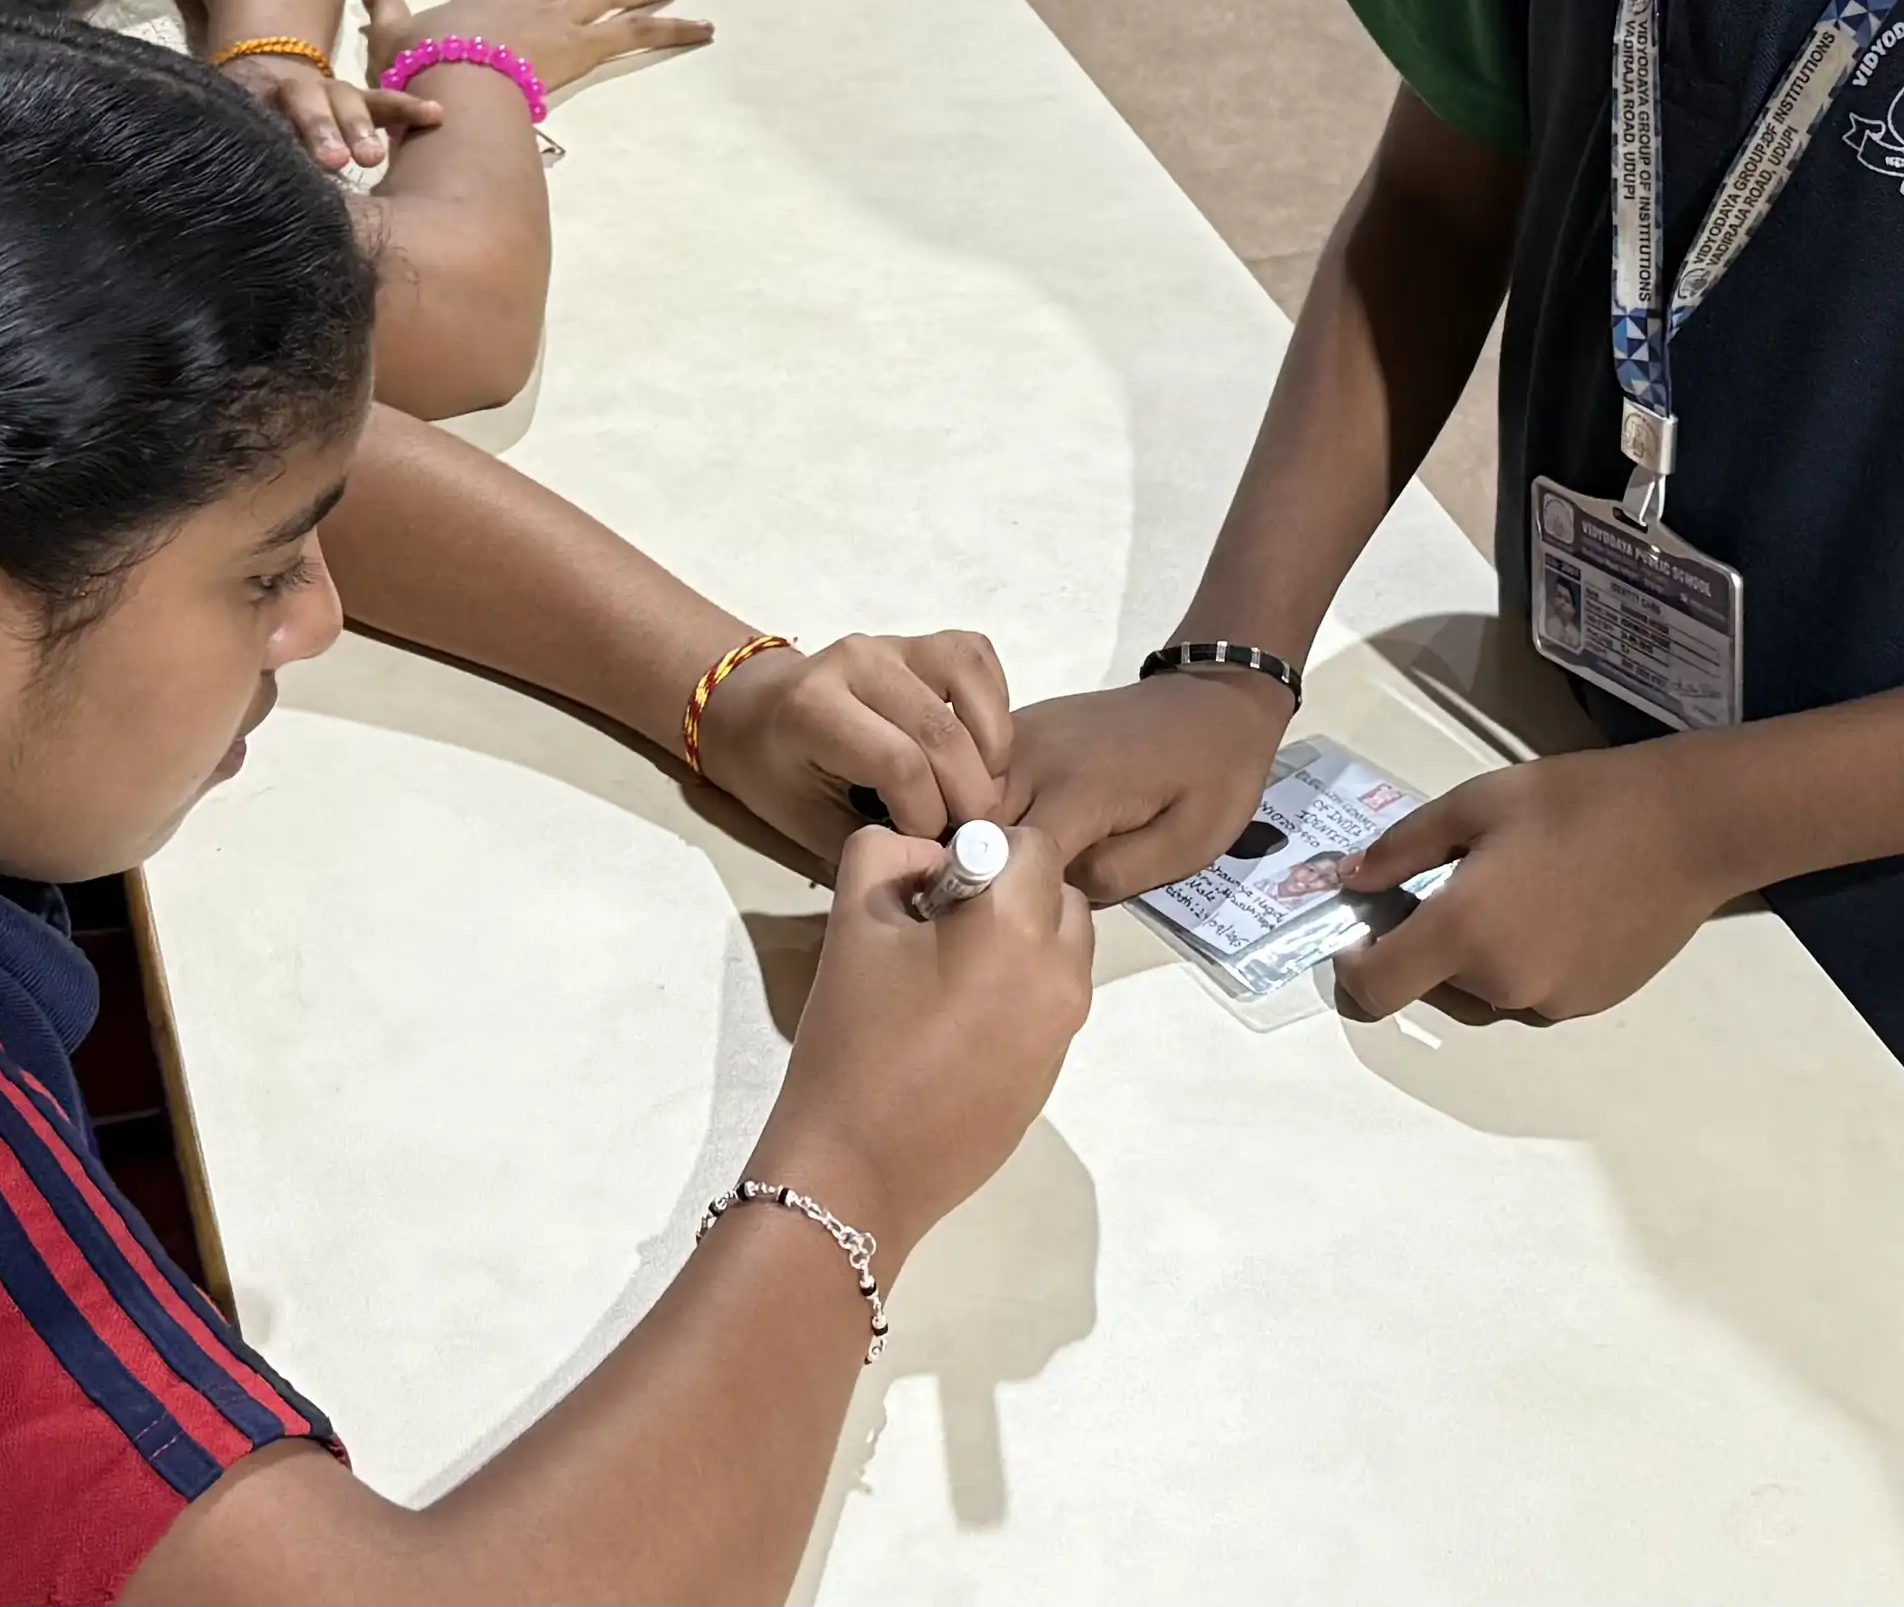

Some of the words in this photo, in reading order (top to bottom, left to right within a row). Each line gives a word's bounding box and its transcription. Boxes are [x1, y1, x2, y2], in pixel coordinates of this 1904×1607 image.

[1622, 19, 1636, 96] VADIRAJA
[1636, 20, 1649, 106] VIDYODAYA
[1623, 150, 1637, 200] UDUPI
[1638, 108, 1651, 166] GROUP
[1694, 193, 1741, 265] VIDYODAYA
[1773, 30, 1836, 125] INSTITUTIONS
[1638, 166, 1652, 192] OF
[1706, 200, 1752, 267] VADIRAJA
[1767, 124, 1798, 169] UDUPI
[1638, 195, 1653, 303] INSTITUTIONS
[1581, 519, 1633, 556] VIDYODAYA
[1671, 565, 1712, 598] SCHOOL
